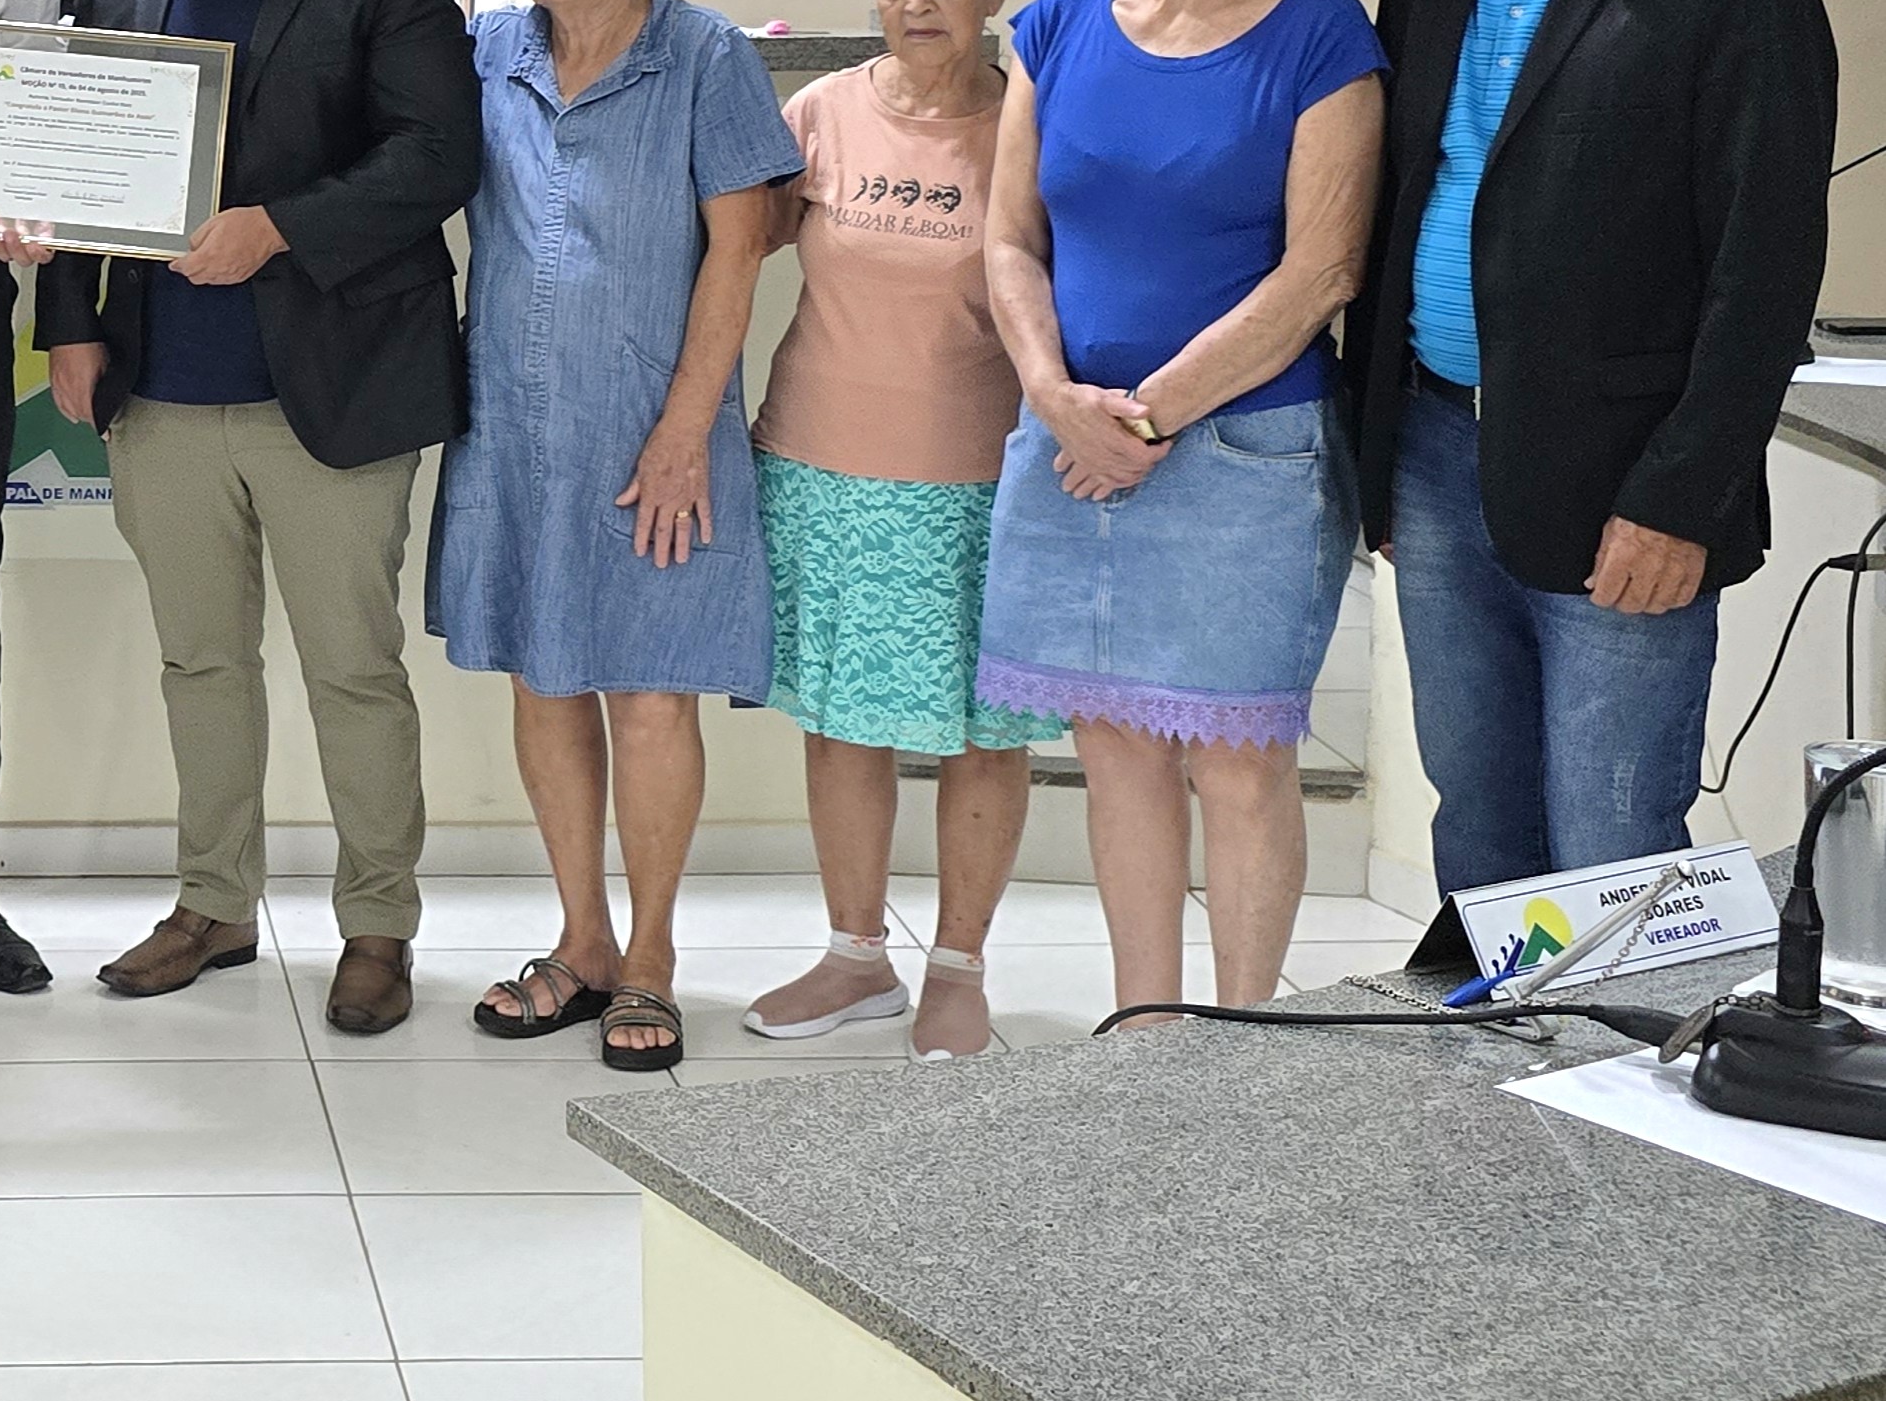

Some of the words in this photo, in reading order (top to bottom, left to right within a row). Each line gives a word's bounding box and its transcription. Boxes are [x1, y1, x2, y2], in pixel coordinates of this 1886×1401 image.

[825, 204, 897, 229] MUDAR
[903, 214, 914, 232] É
[920, 218, 974, 239] BOM!
[42, 487, 64, 500] DE
[1685, 867, 1732, 889] VIDAL
[1645, 917, 1723, 946] VEREADOR
